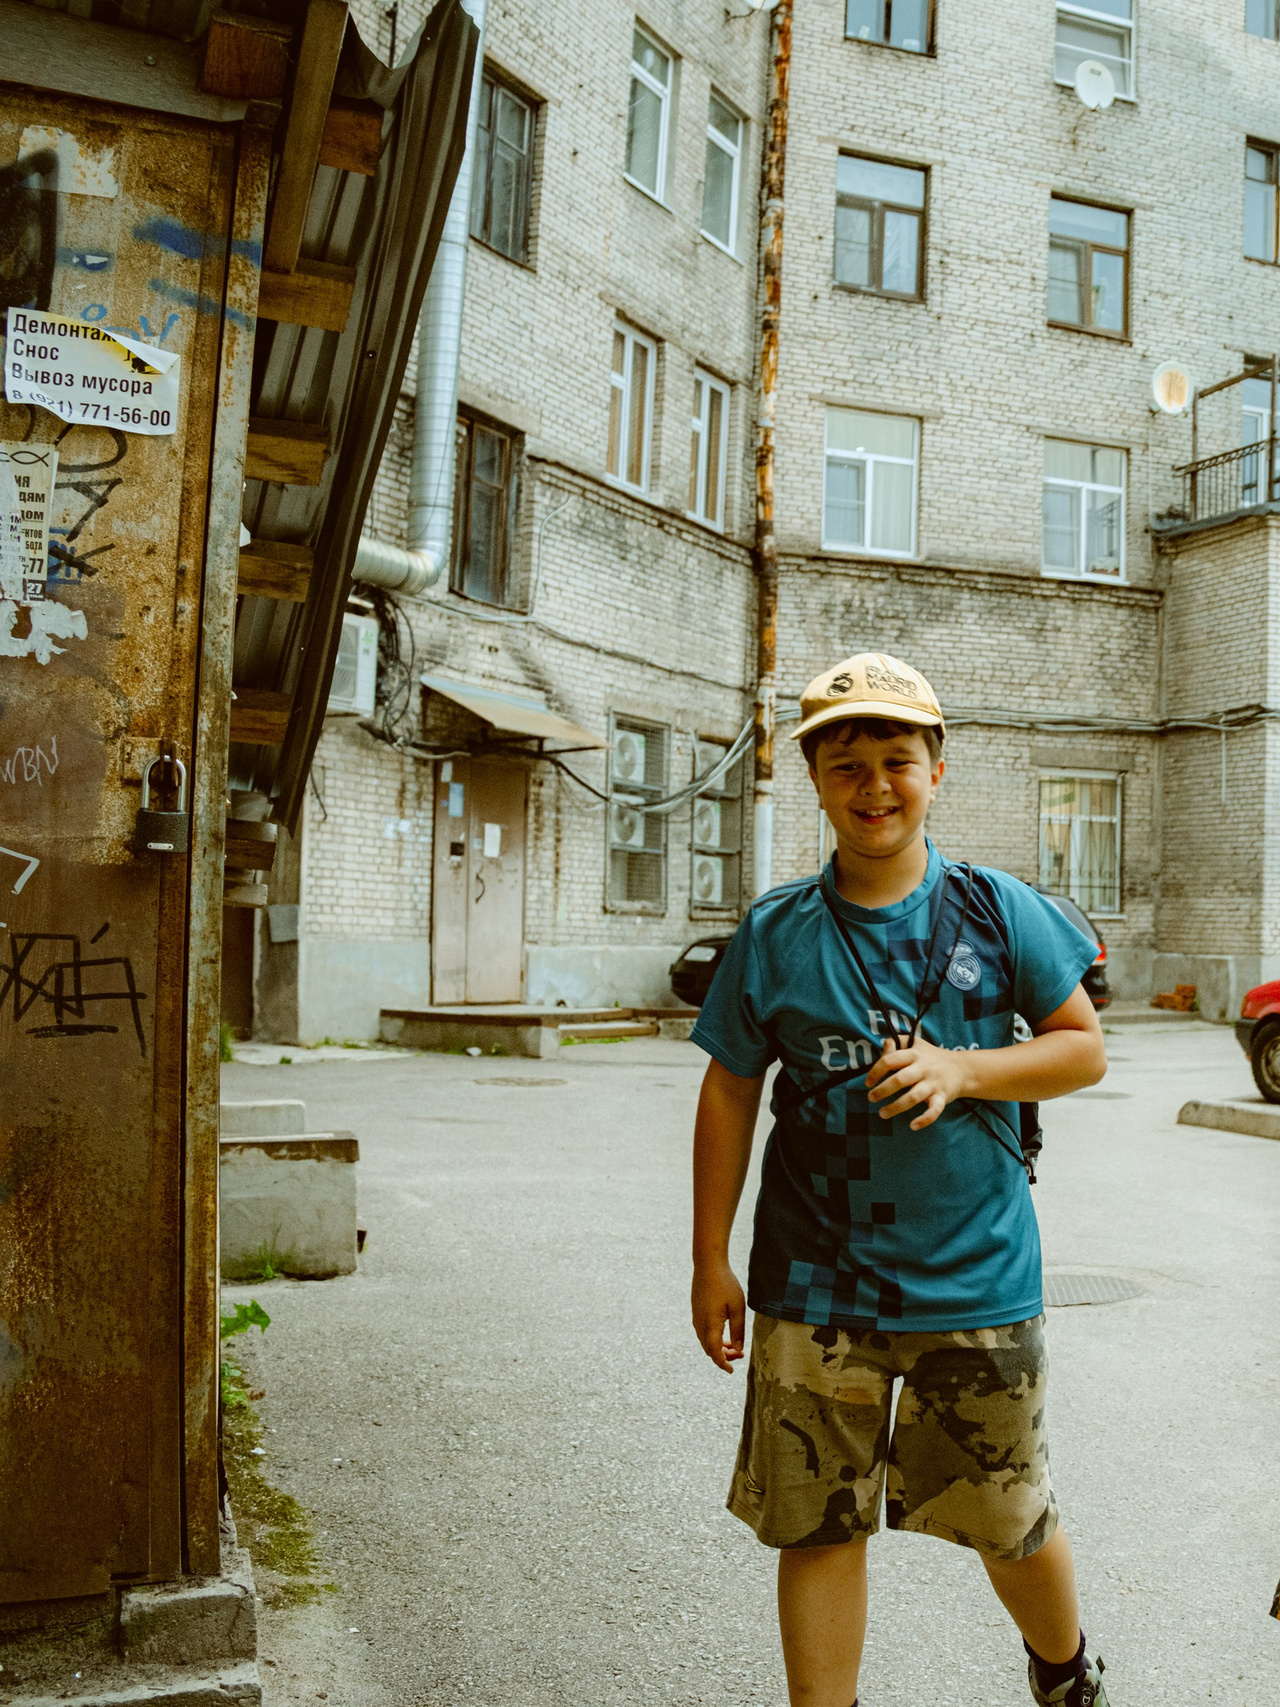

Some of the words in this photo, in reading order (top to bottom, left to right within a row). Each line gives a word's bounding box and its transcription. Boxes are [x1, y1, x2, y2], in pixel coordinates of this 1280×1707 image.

[13, 338, 60, 361] Снос
[12, 362, 75, 387] Вывоз
[82, 375, 153, 397] мусора
[12, 389, 23, 400] 8
[29, 392, 74, 418] (921)
[79, 402, 171, 427] 771-56-00
[866, 673, 917, 691] MADRID
[867, 681, 916, 699] WORLD
